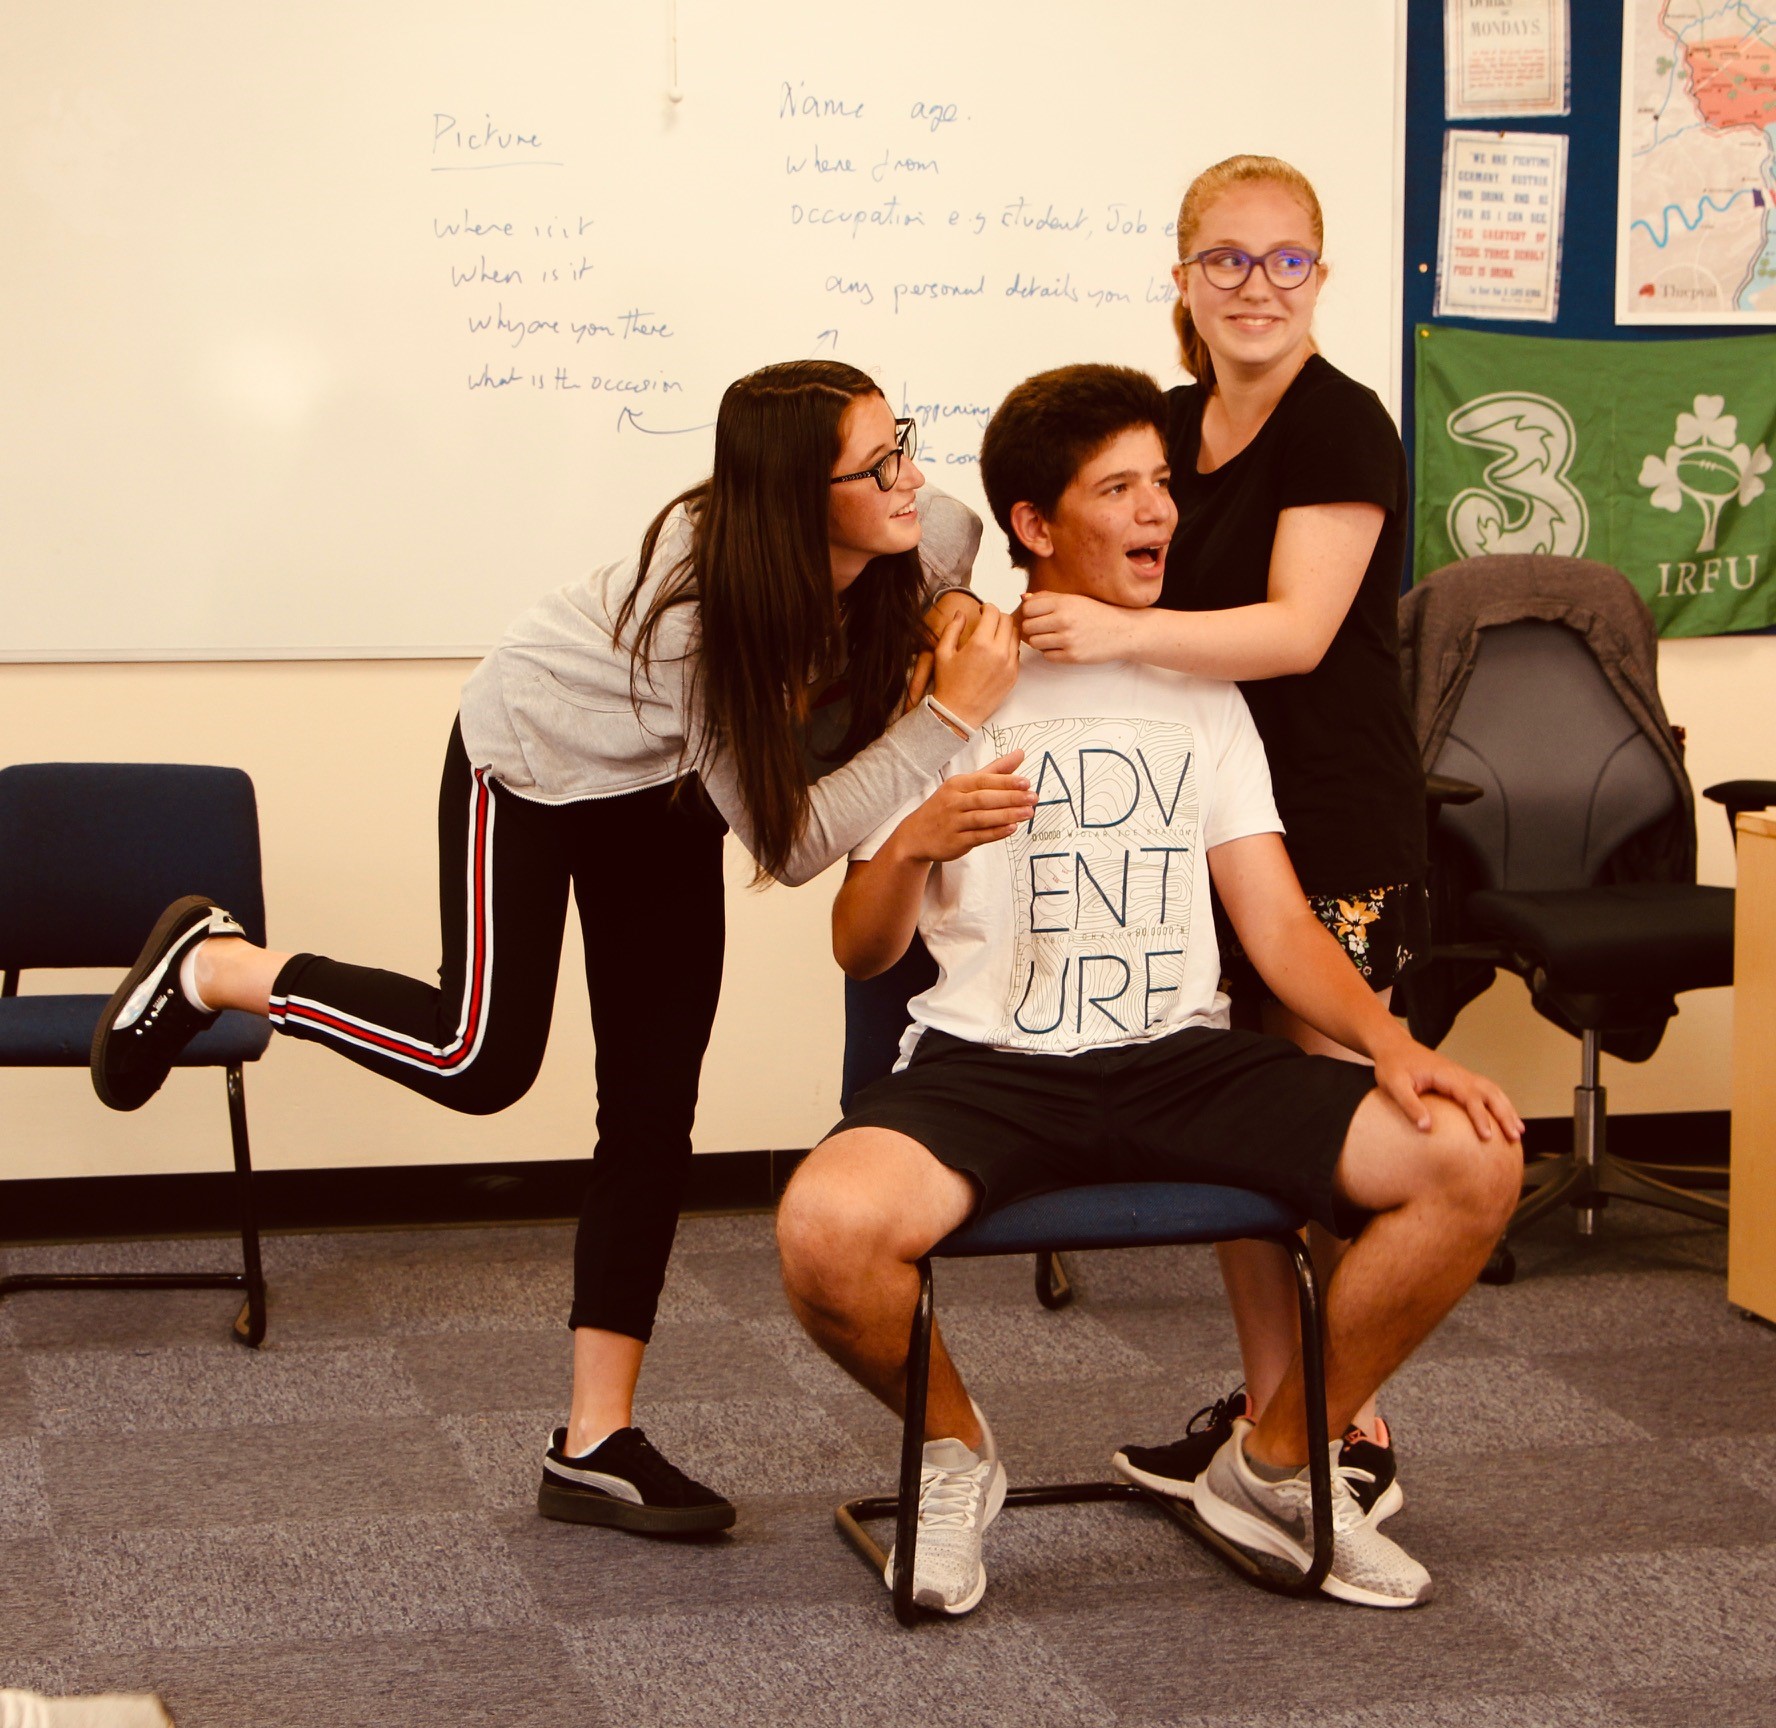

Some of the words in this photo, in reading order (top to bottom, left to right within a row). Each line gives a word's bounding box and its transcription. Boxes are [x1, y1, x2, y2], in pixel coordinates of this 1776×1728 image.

[780, 80, 865, 119] Name
[433, 112, 542, 154] Picture
[543, 269, 558, 283] is
[568, 256, 594, 281] it
[825, 274, 874, 306] any
[893, 275, 985, 315] personal
[1005, 272, 1078, 303] details
[571, 321, 615, 344] you
[617, 307, 674, 340] there
[531, 373, 544, 389] is
[1657, 554, 1760, 598] IRFU
[1026, 747, 1192, 834] ADV
[1029, 847, 1189, 934] ENT
[1014, 949, 1184, 1035] URE
